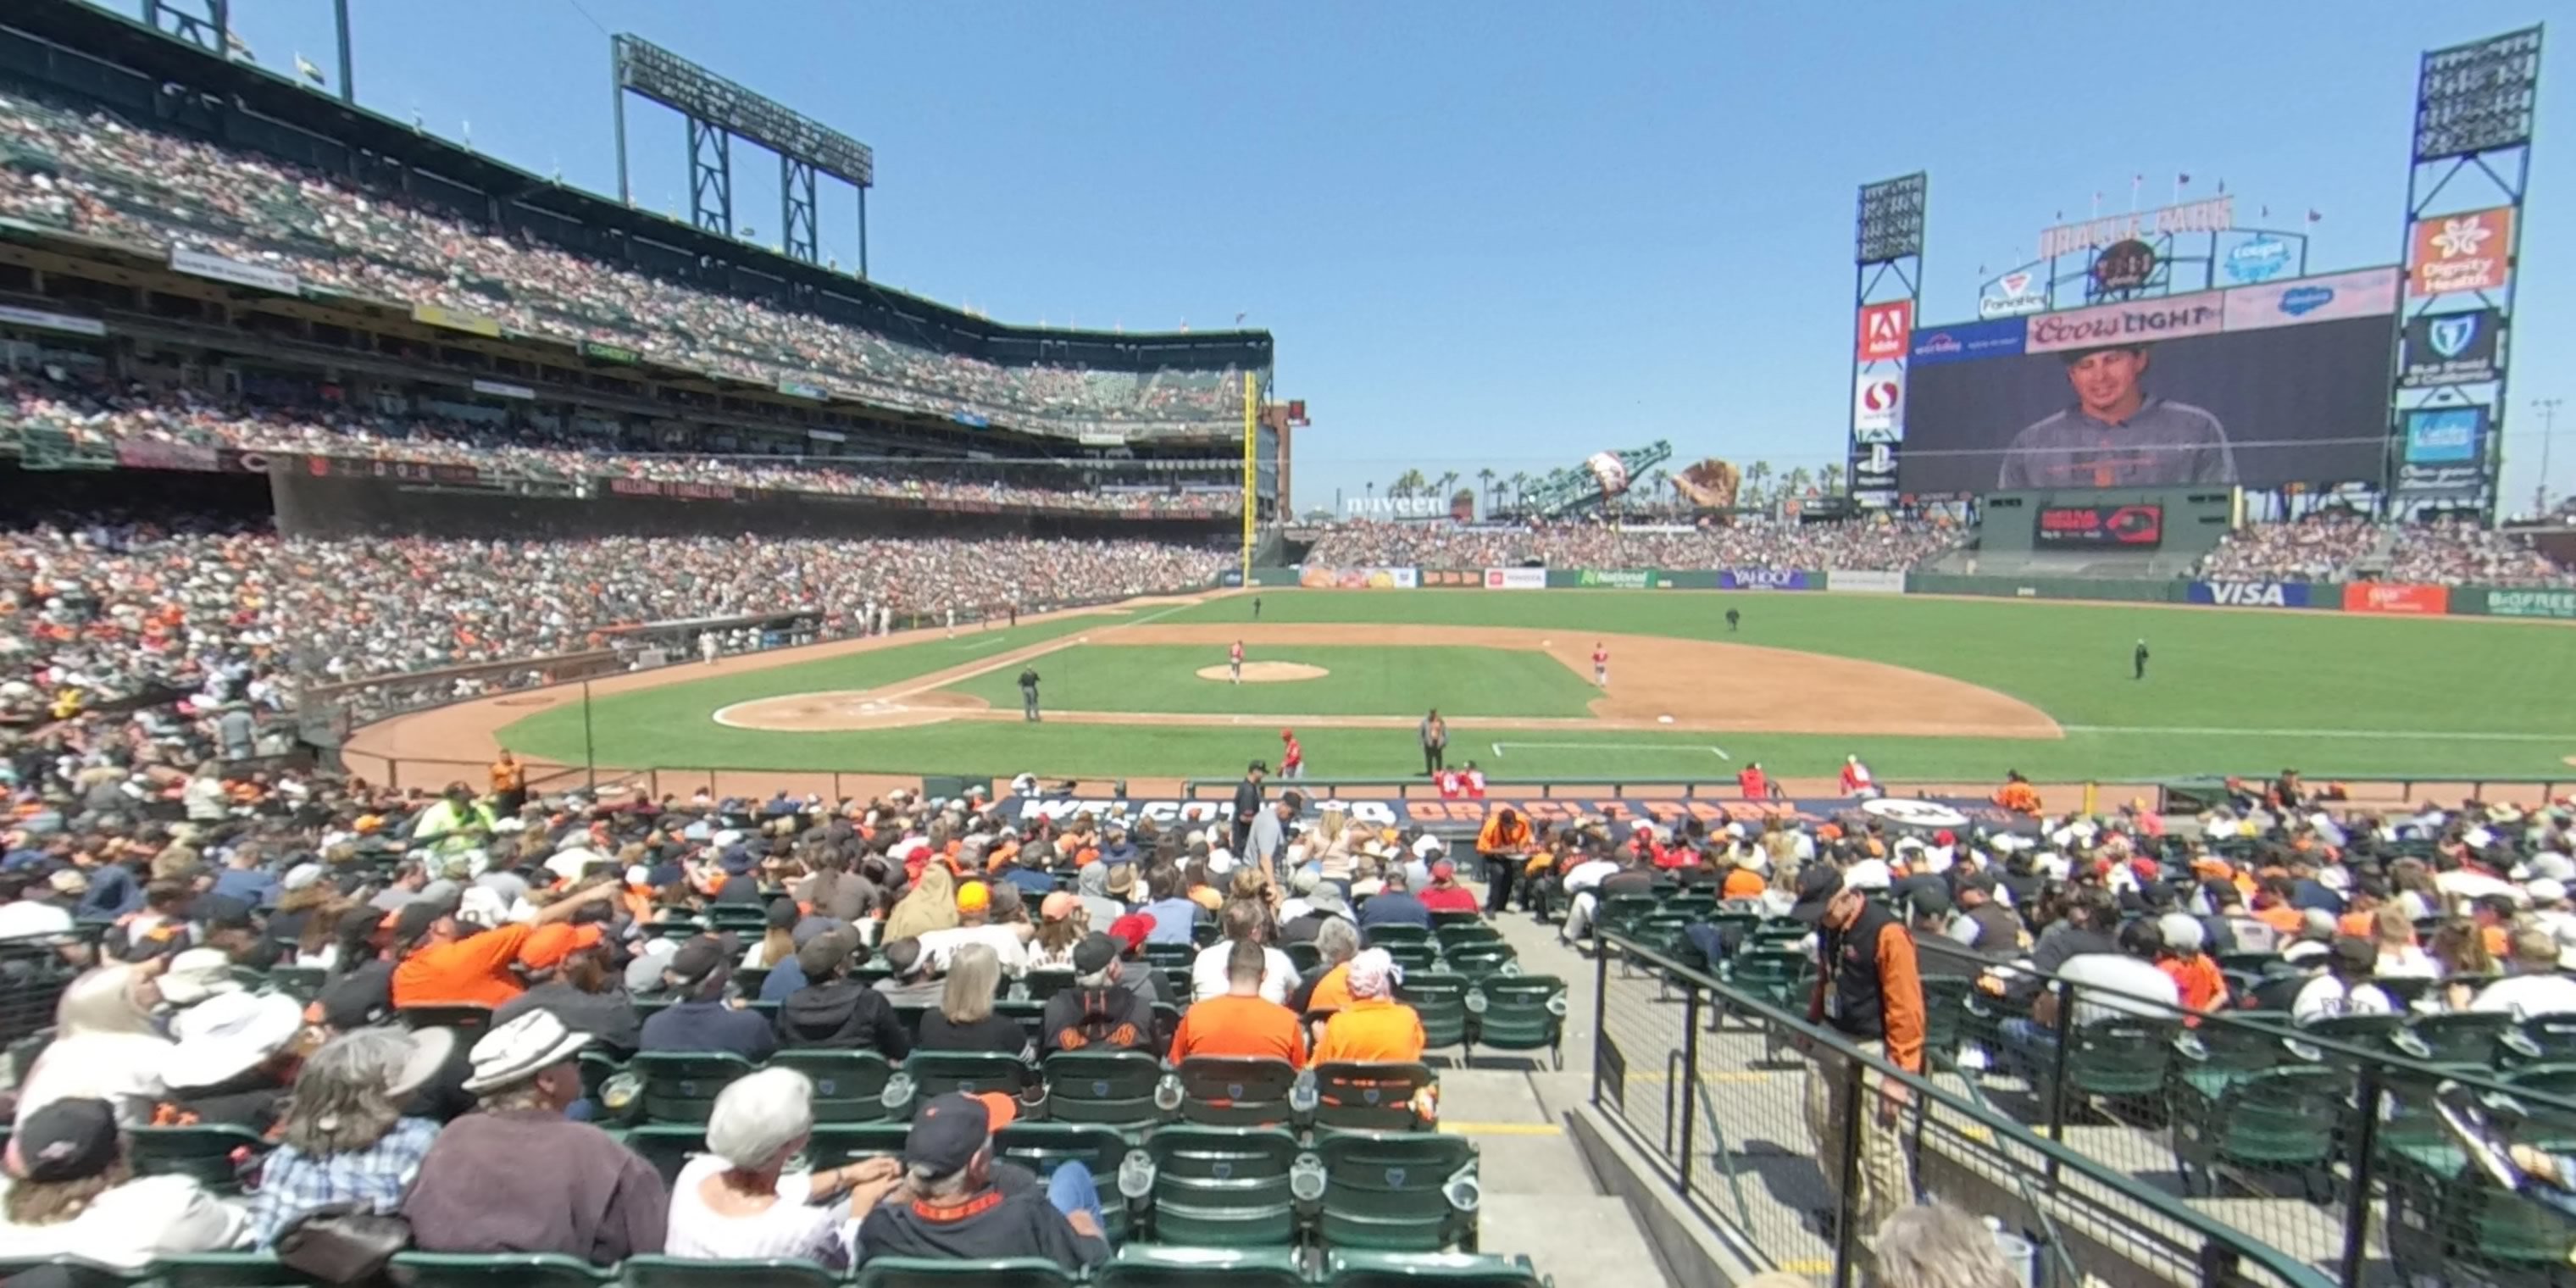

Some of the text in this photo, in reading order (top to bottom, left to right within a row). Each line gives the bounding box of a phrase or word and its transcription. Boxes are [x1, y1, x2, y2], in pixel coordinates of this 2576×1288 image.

[2155, 197, 2233, 234] PARK
[2422, 258, 2494, 280] Dignity
[2425, 272, 2490, 293] Health
[1984, 294, 2046, 310] Fanatics
[2034, 316, 2118, 343] Coors
[2123, 306, 2209, 333] LIGHT
[1346, 497, 1443, 514] nuveen
[1597, 571, 1648, 583] National
[1733, 569, 1790, 586] YAHOO!
[2207, 580, 2285, 607] VISA
